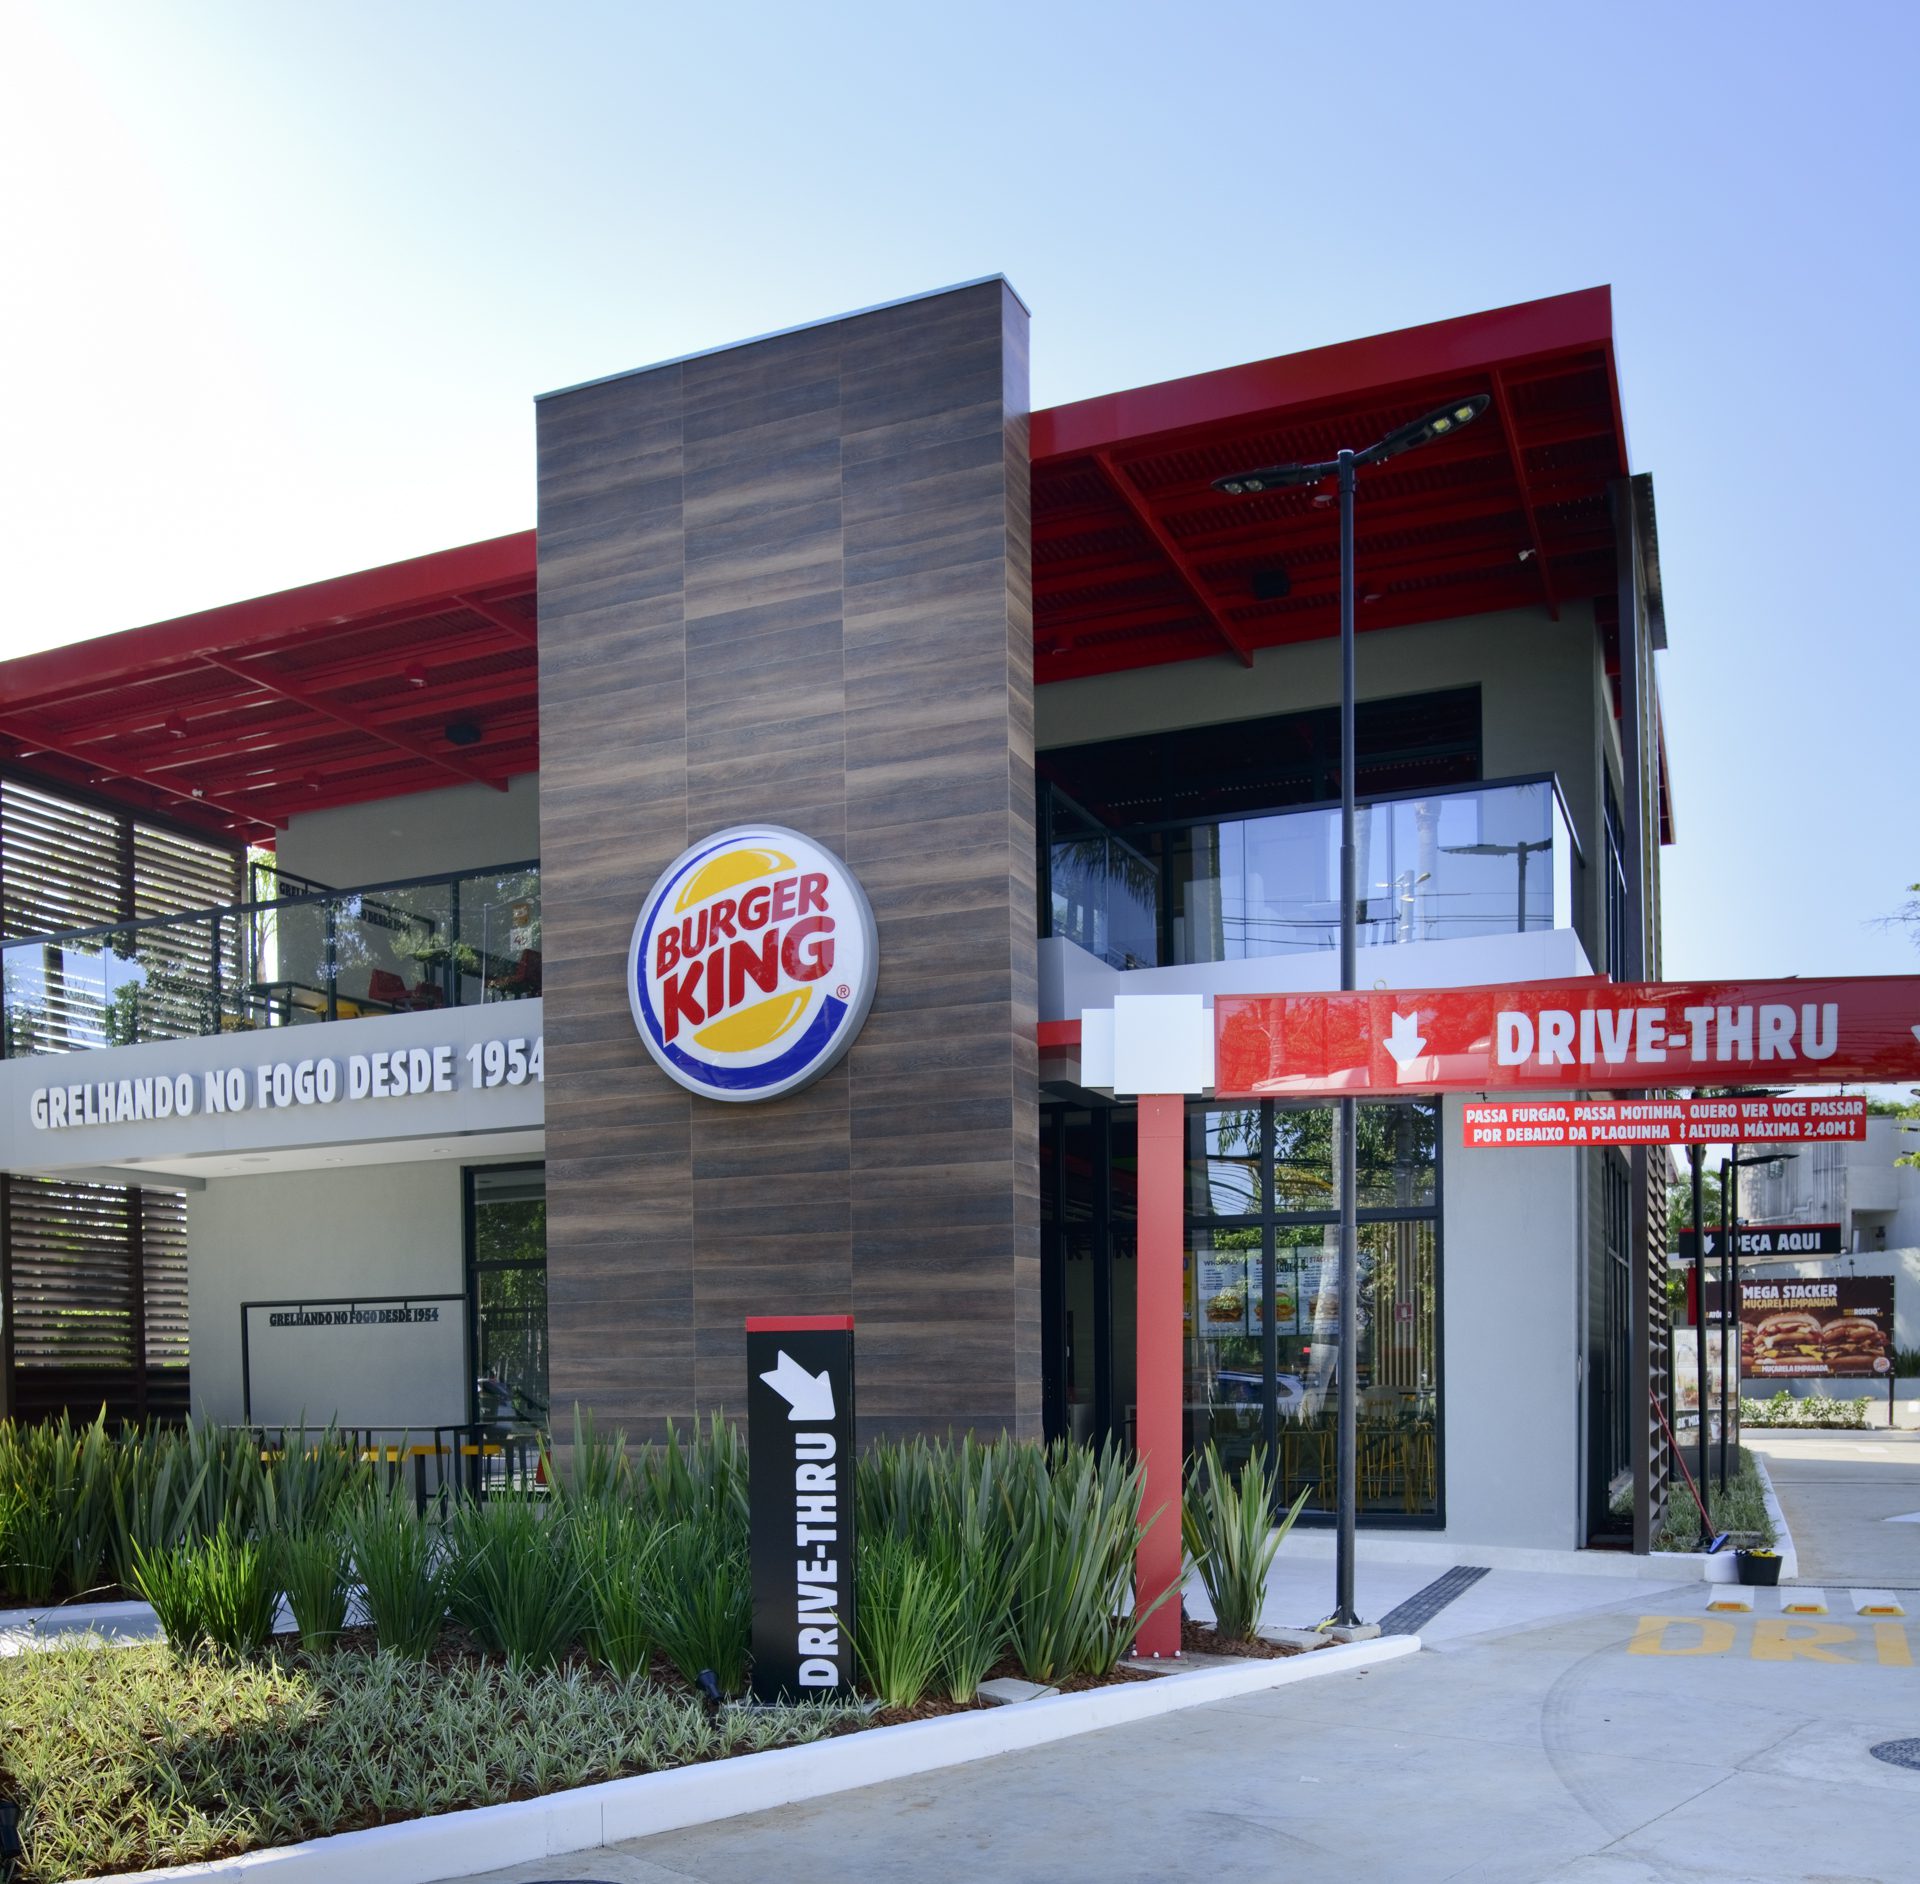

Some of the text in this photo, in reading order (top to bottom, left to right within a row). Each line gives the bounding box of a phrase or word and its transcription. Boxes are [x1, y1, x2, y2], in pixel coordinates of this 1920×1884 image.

[656, 872, 830, 980] BURGER
[663, 915, 836, 1044] KING
[1497, 1003, 1839, 1066] DRIVE-THRU
[30, 1036, 544, 1130] GRELHANDO NO FOGO DESDE 1954
[1466, 1101, 1864, 1123] PASSA FURGAO, PASSA MOTINHA, QUERO VER VOCE PASSAR
[1473, 1120, 1846, 1142] POR DEBAIXO DA PLAQUINHA ALTURA MÁXIMA 2,40M
[1777, 1233, 1821, 1251] AQUI
[1742, 1284, 1838, 1299] MEGA STACKER
[1742, 1297, 1838, 1310] MUÇARELA EMPANADA
[269, 1307, 439, 1327] GRELHANDO NO FOGO DESDE 1954
[795, 1432, 839, 1687] DRIVE-THRU
